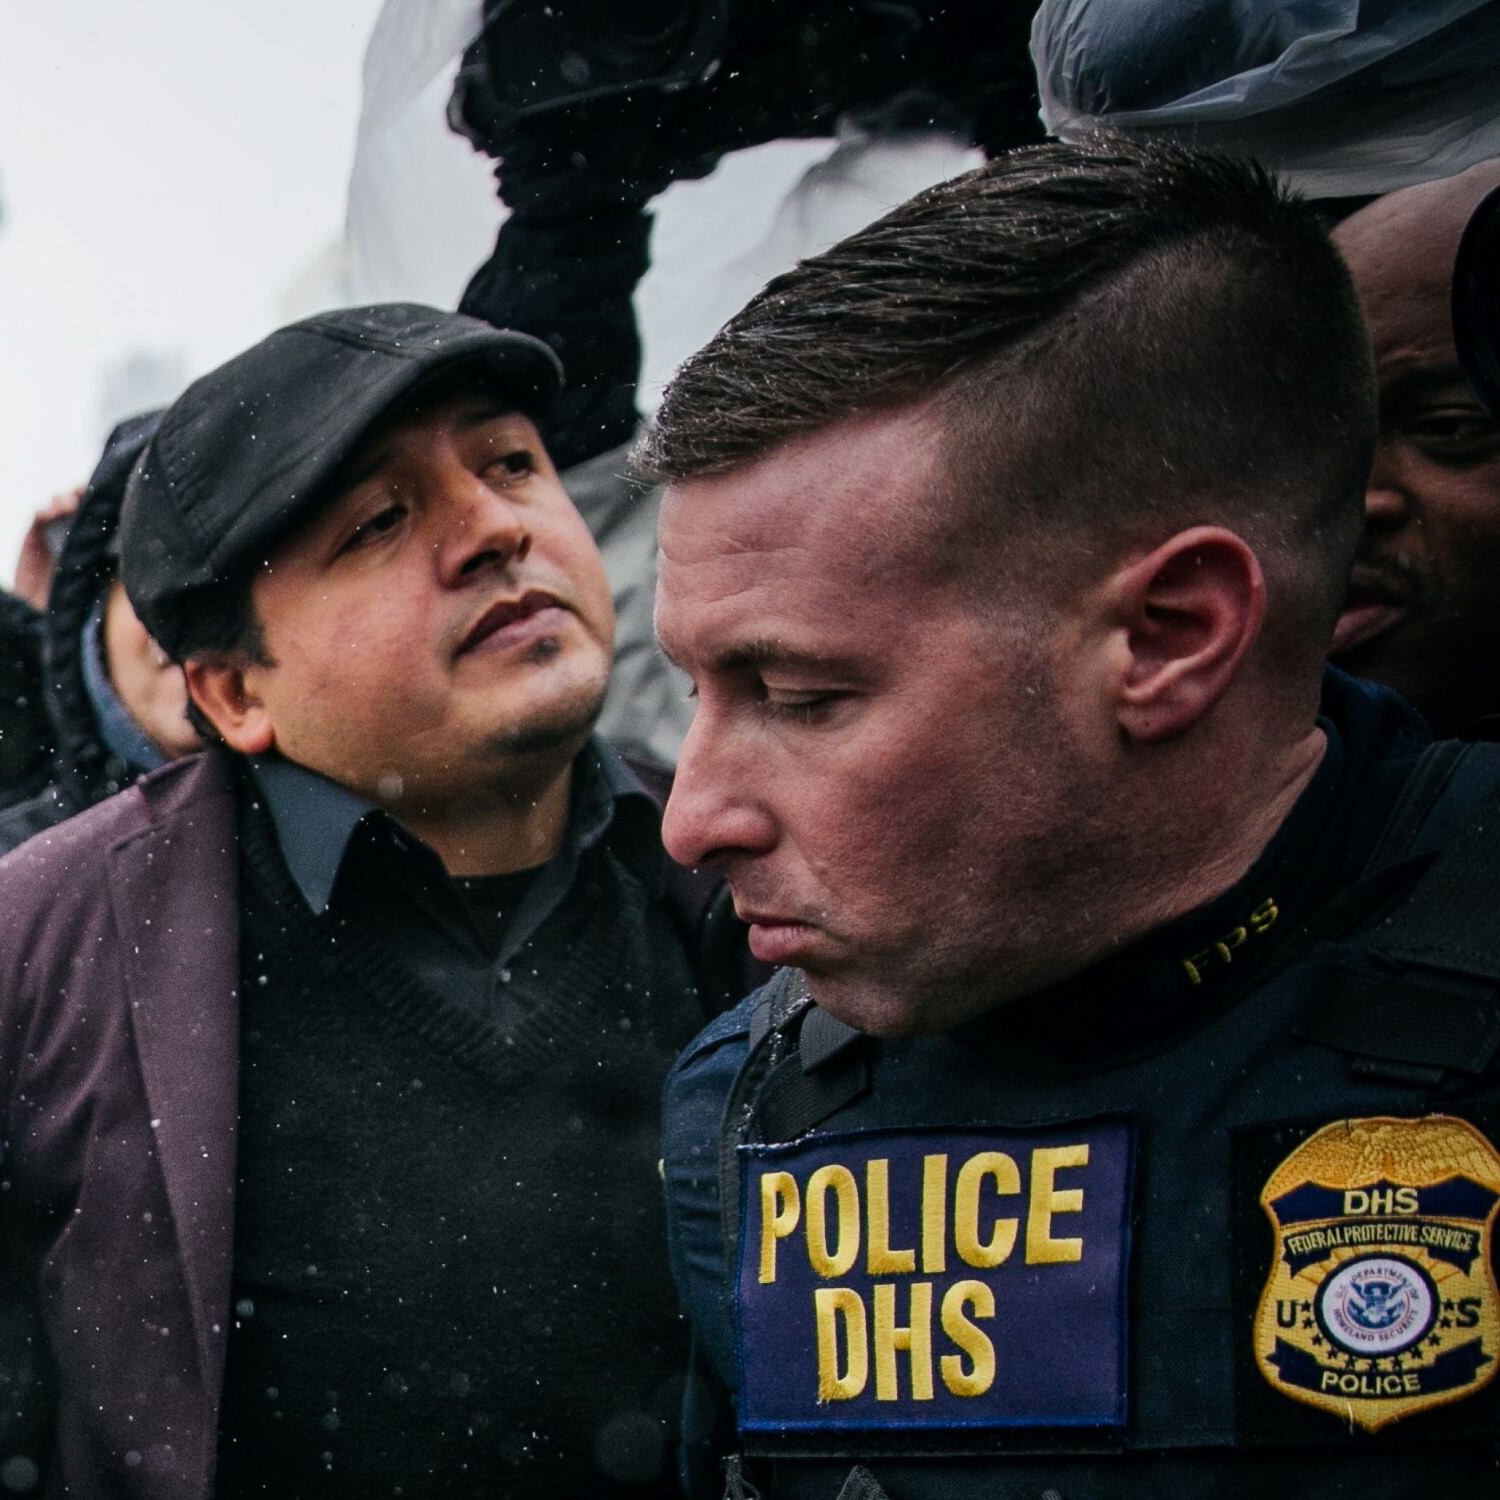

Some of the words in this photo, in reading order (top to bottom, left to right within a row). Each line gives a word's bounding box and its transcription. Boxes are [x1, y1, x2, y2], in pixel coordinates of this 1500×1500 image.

[759, 1144, 1089, 1284] POLICE
[1343, 1188, 1419, 1215] DHS
[1287, 1227, 1343, 1255] FEDERAL
[1345, 1223, 1419, 1244] PROTECTIVE
[1420, 1225, 1474, 1251] SERVICE
[1276, 1299, 1297, 1327] U
[1455, 1297, 1482, 1327] S
[1334, 1308, 1375, 1342] HOMELAND
[1378, 1309, 1419, 1342] SECURITY
[815, 1280, 996, 1404] DHS
[1321, 1371, 1421, 1395] POLICE
